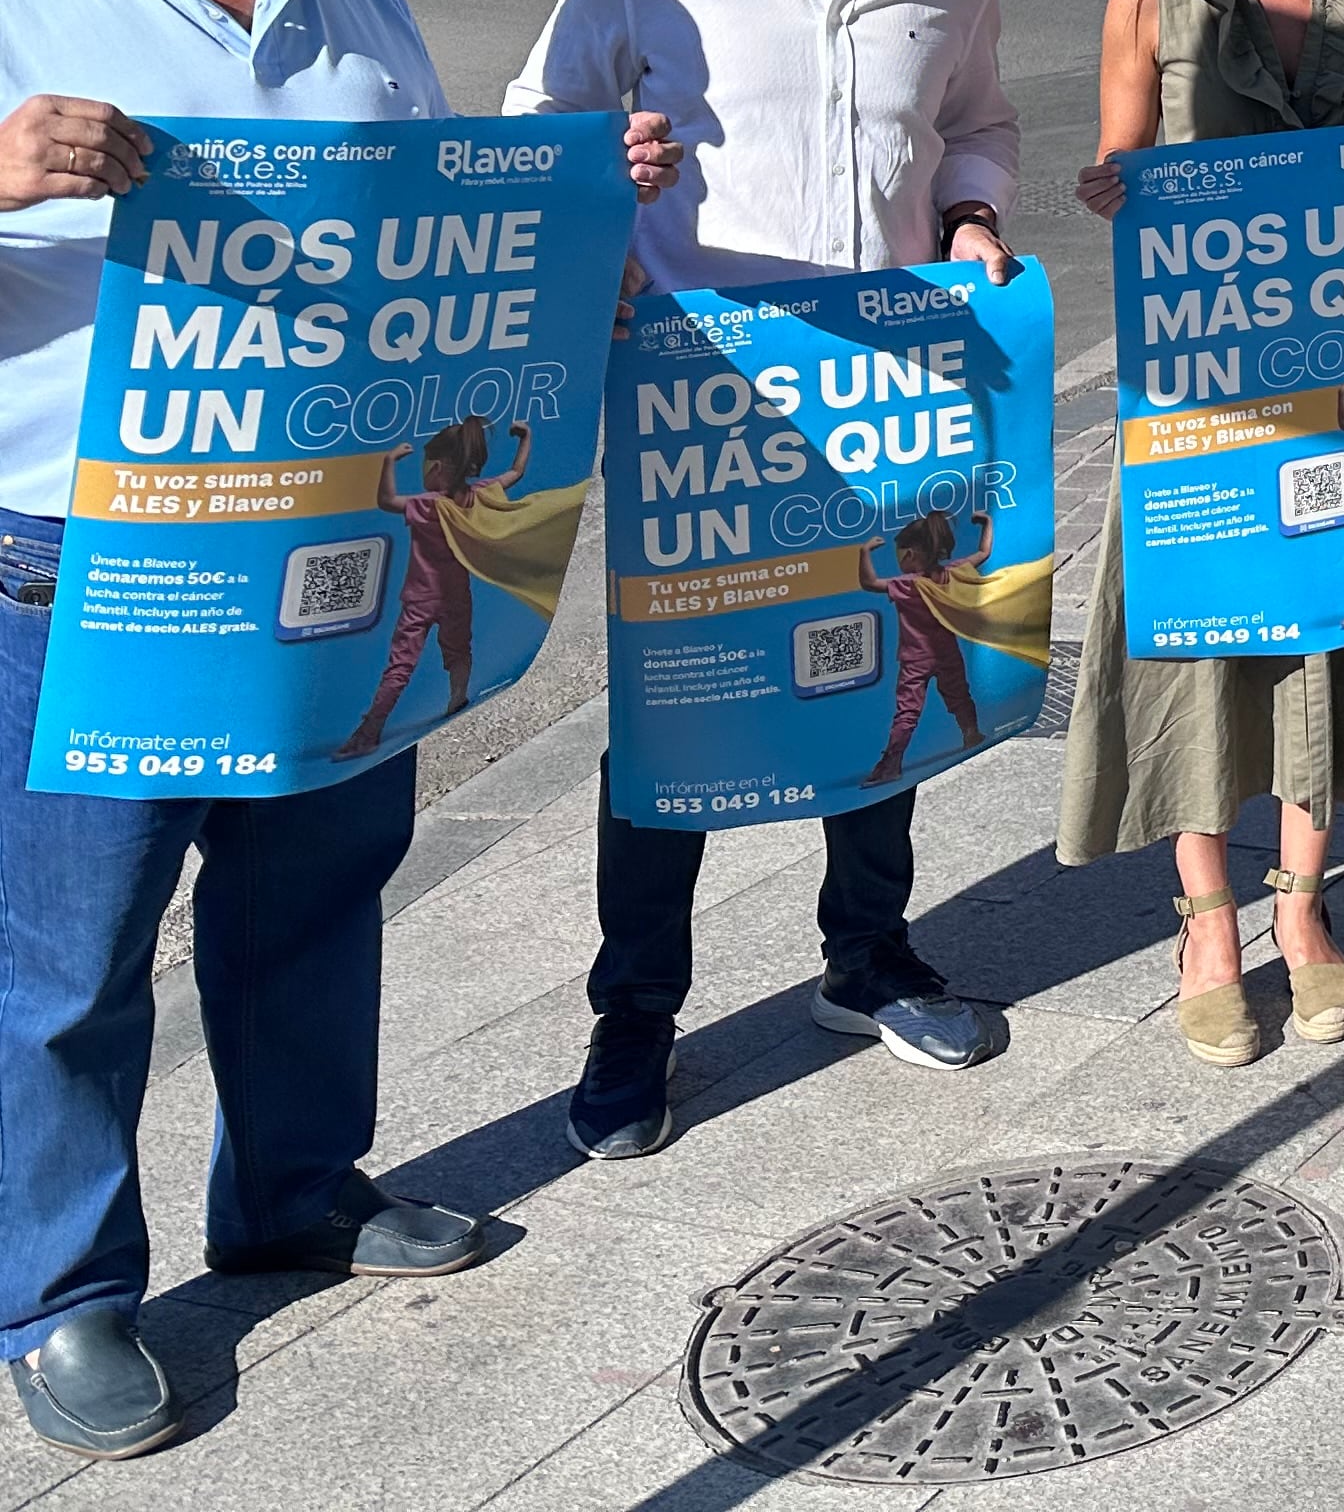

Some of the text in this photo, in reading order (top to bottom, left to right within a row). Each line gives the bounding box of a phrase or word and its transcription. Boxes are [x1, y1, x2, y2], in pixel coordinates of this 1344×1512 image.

[144, 211, 541, 285] NOS UNE
[1140, 214, 1287, 283] NOS
[131, 289, 536, 369] MÁS QUE
[1143, 270, 1293, 345] MÁS
[120, 362, 567, 454] UN COLOR
[638, 340, 965, 437] NOS UNE
[1146, 347, 1240, 407] UN
[639, 404, 975, 502] MÁS QUE
[644, 460, 1017, 568] UN COLOR
[1154, 624, 1300, 646] 953 049 184
[66, 750, 276, 776] 953 049 184
[656, 785, 815, 813] 953 049 184
